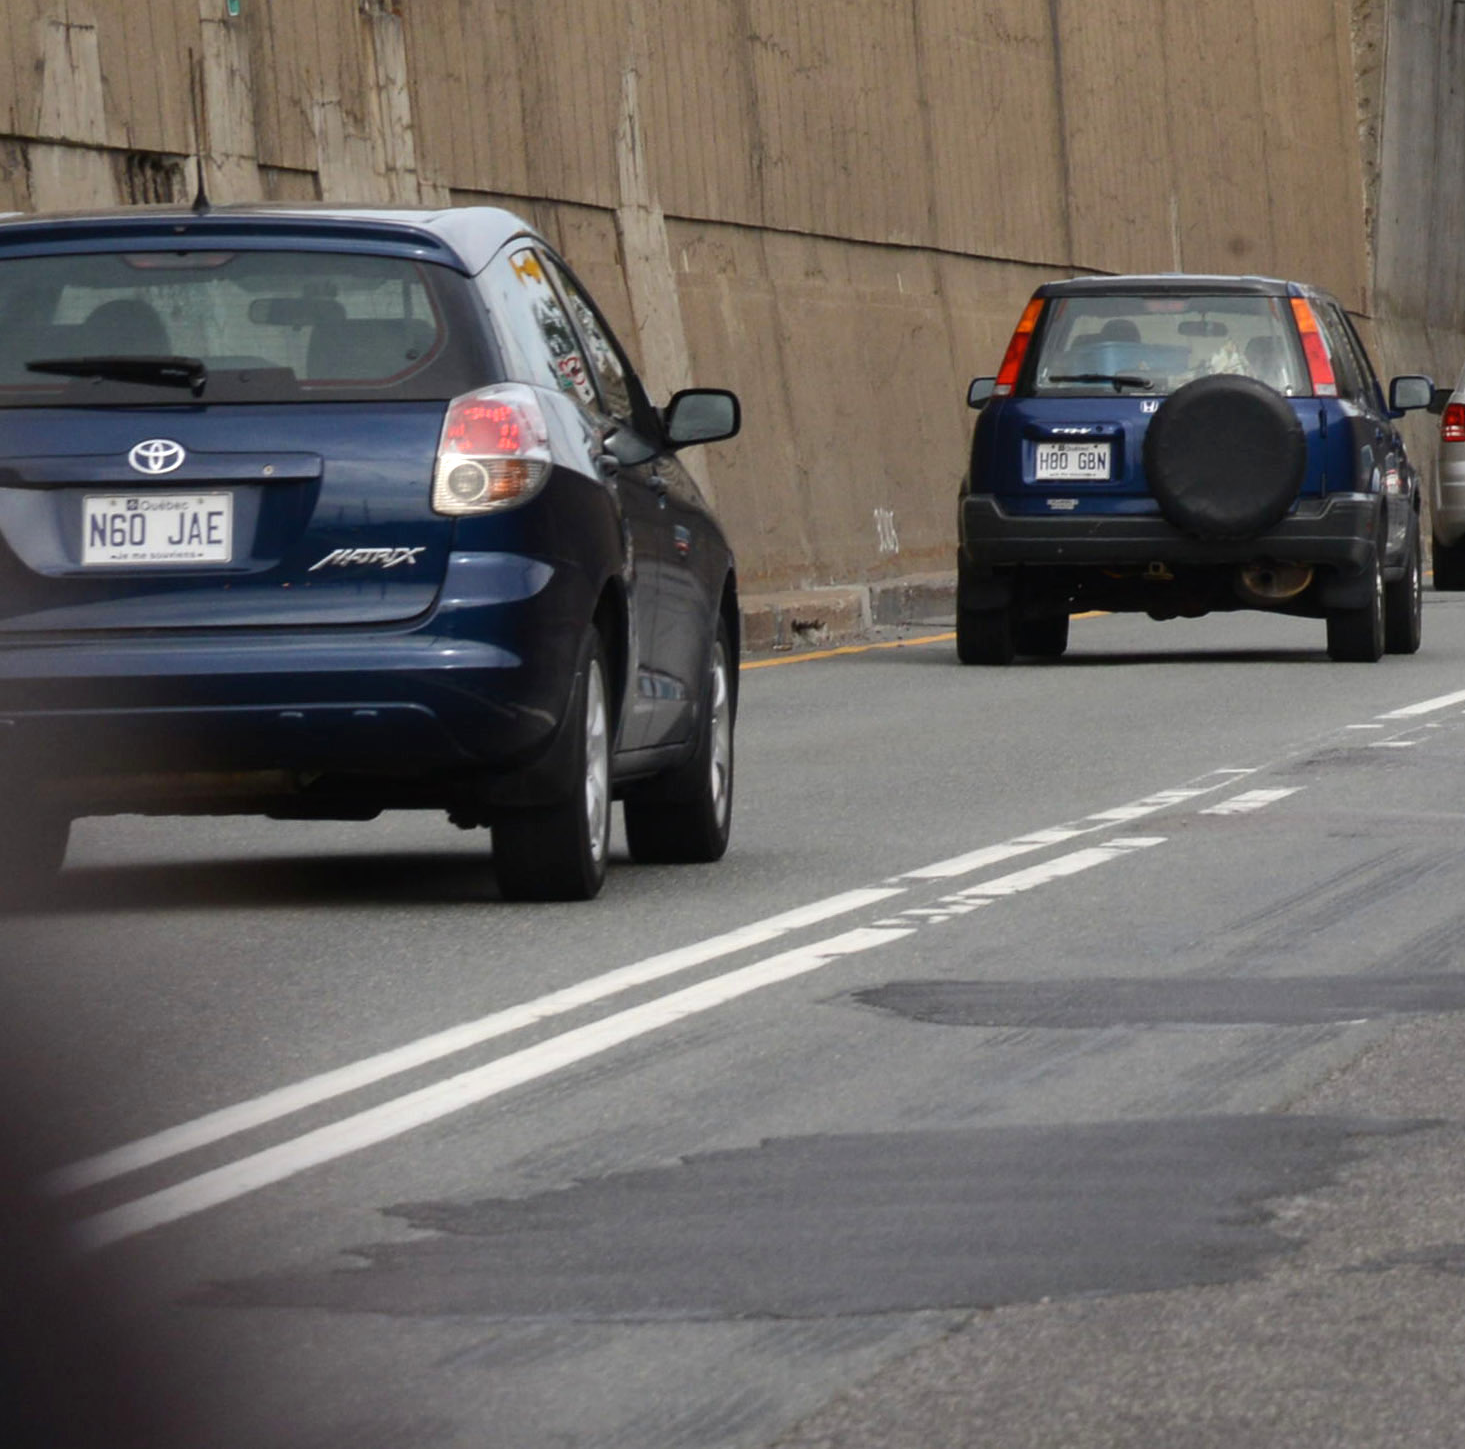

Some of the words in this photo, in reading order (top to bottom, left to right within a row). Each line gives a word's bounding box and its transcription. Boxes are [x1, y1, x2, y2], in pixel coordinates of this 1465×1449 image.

[1039, 452, 1069, 470] H80
[1078, 452, 1107, 470] GBN
[141, 500, 190, 512] Québec
[90, 513, 146, 548] N60
[167, 510, 224, 545] JAE
